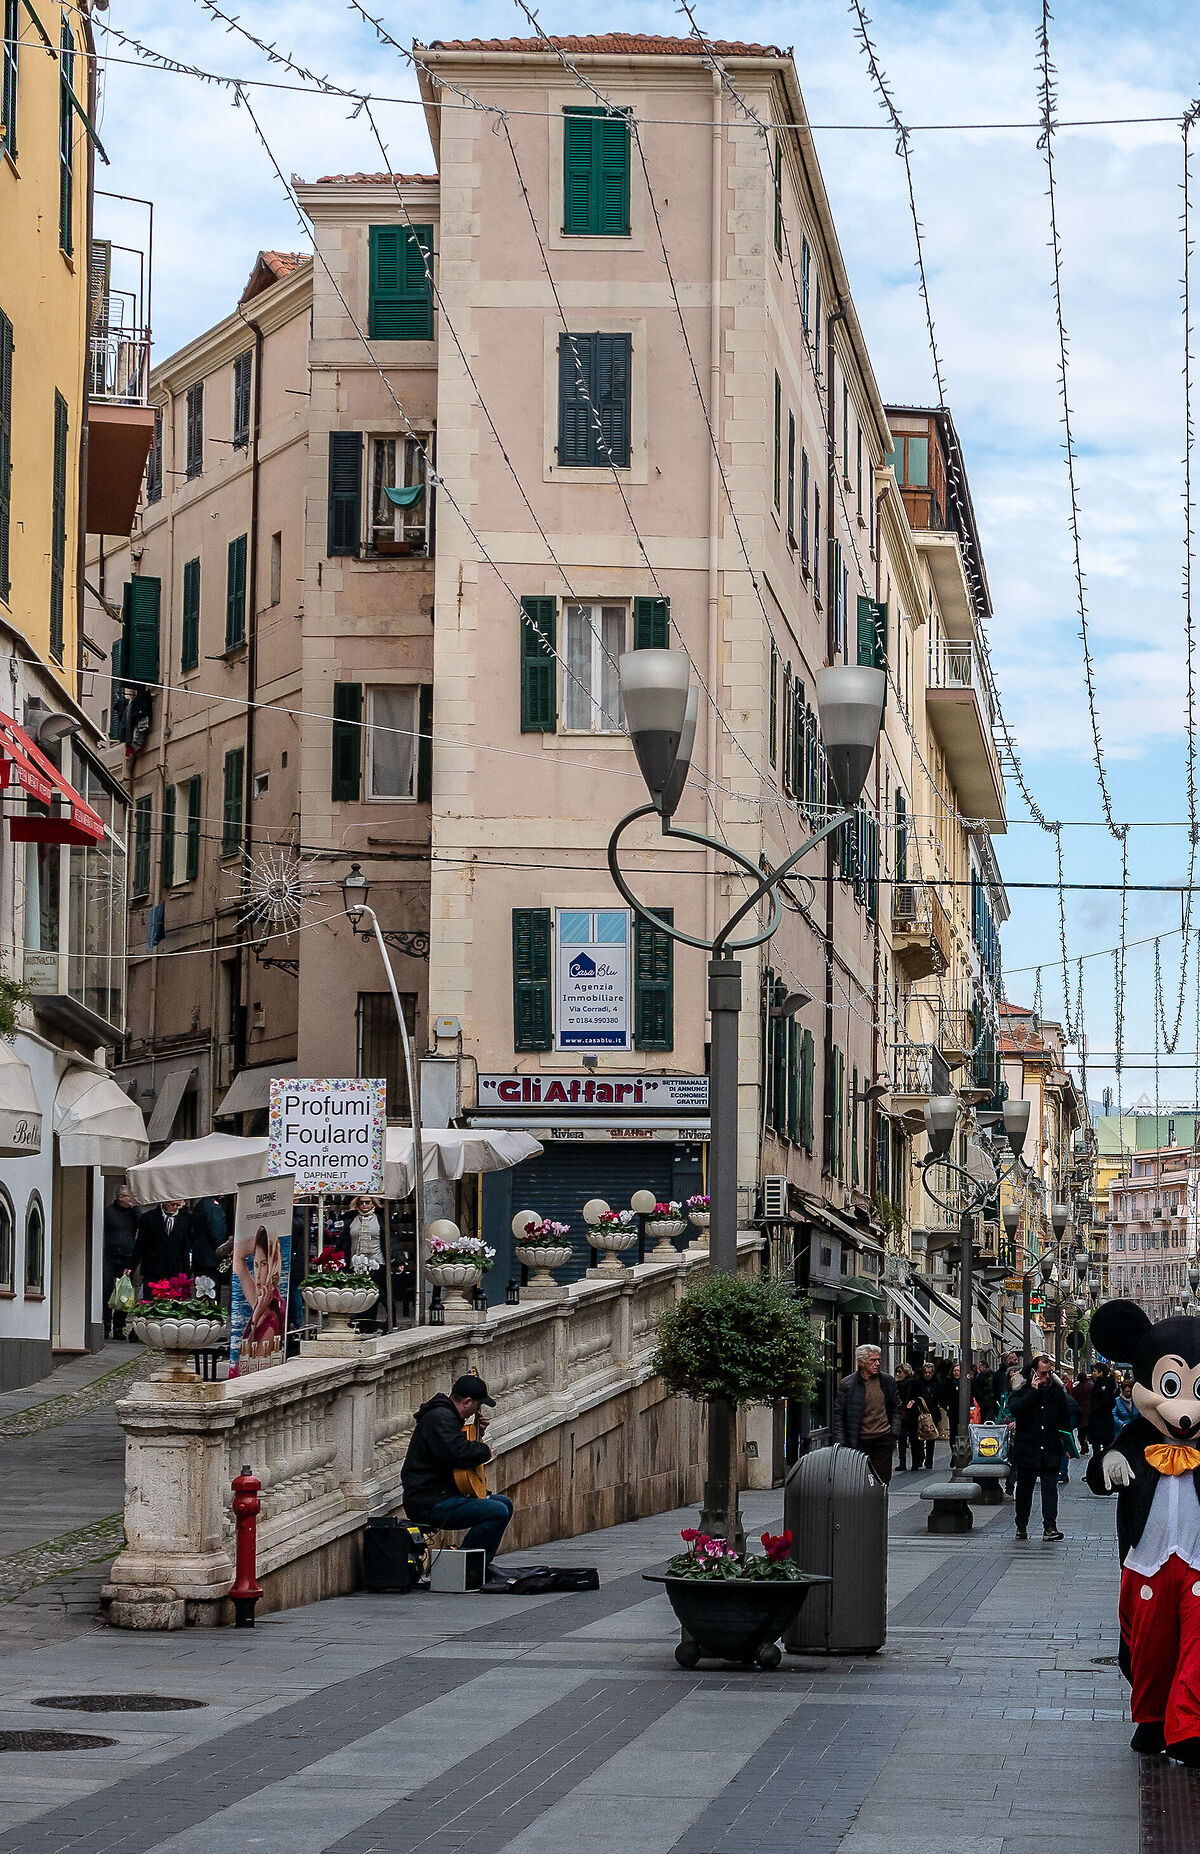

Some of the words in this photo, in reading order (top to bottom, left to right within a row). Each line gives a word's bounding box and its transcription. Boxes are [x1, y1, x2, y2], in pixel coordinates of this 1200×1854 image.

[570, 963, 595, 977] Casa
[597, 963, 618, 977] Blu
[574, 983, 614, 992] Agenzia
[562, 994, 624, 1002] Immobiliare
[285, 1096, 370, 1116] Profumi
[285, 1124, 369, 1144] Foulard
[550, 1129, 584, 1140] Riviera
[284, 1150, 369, 1168] Sanremo
